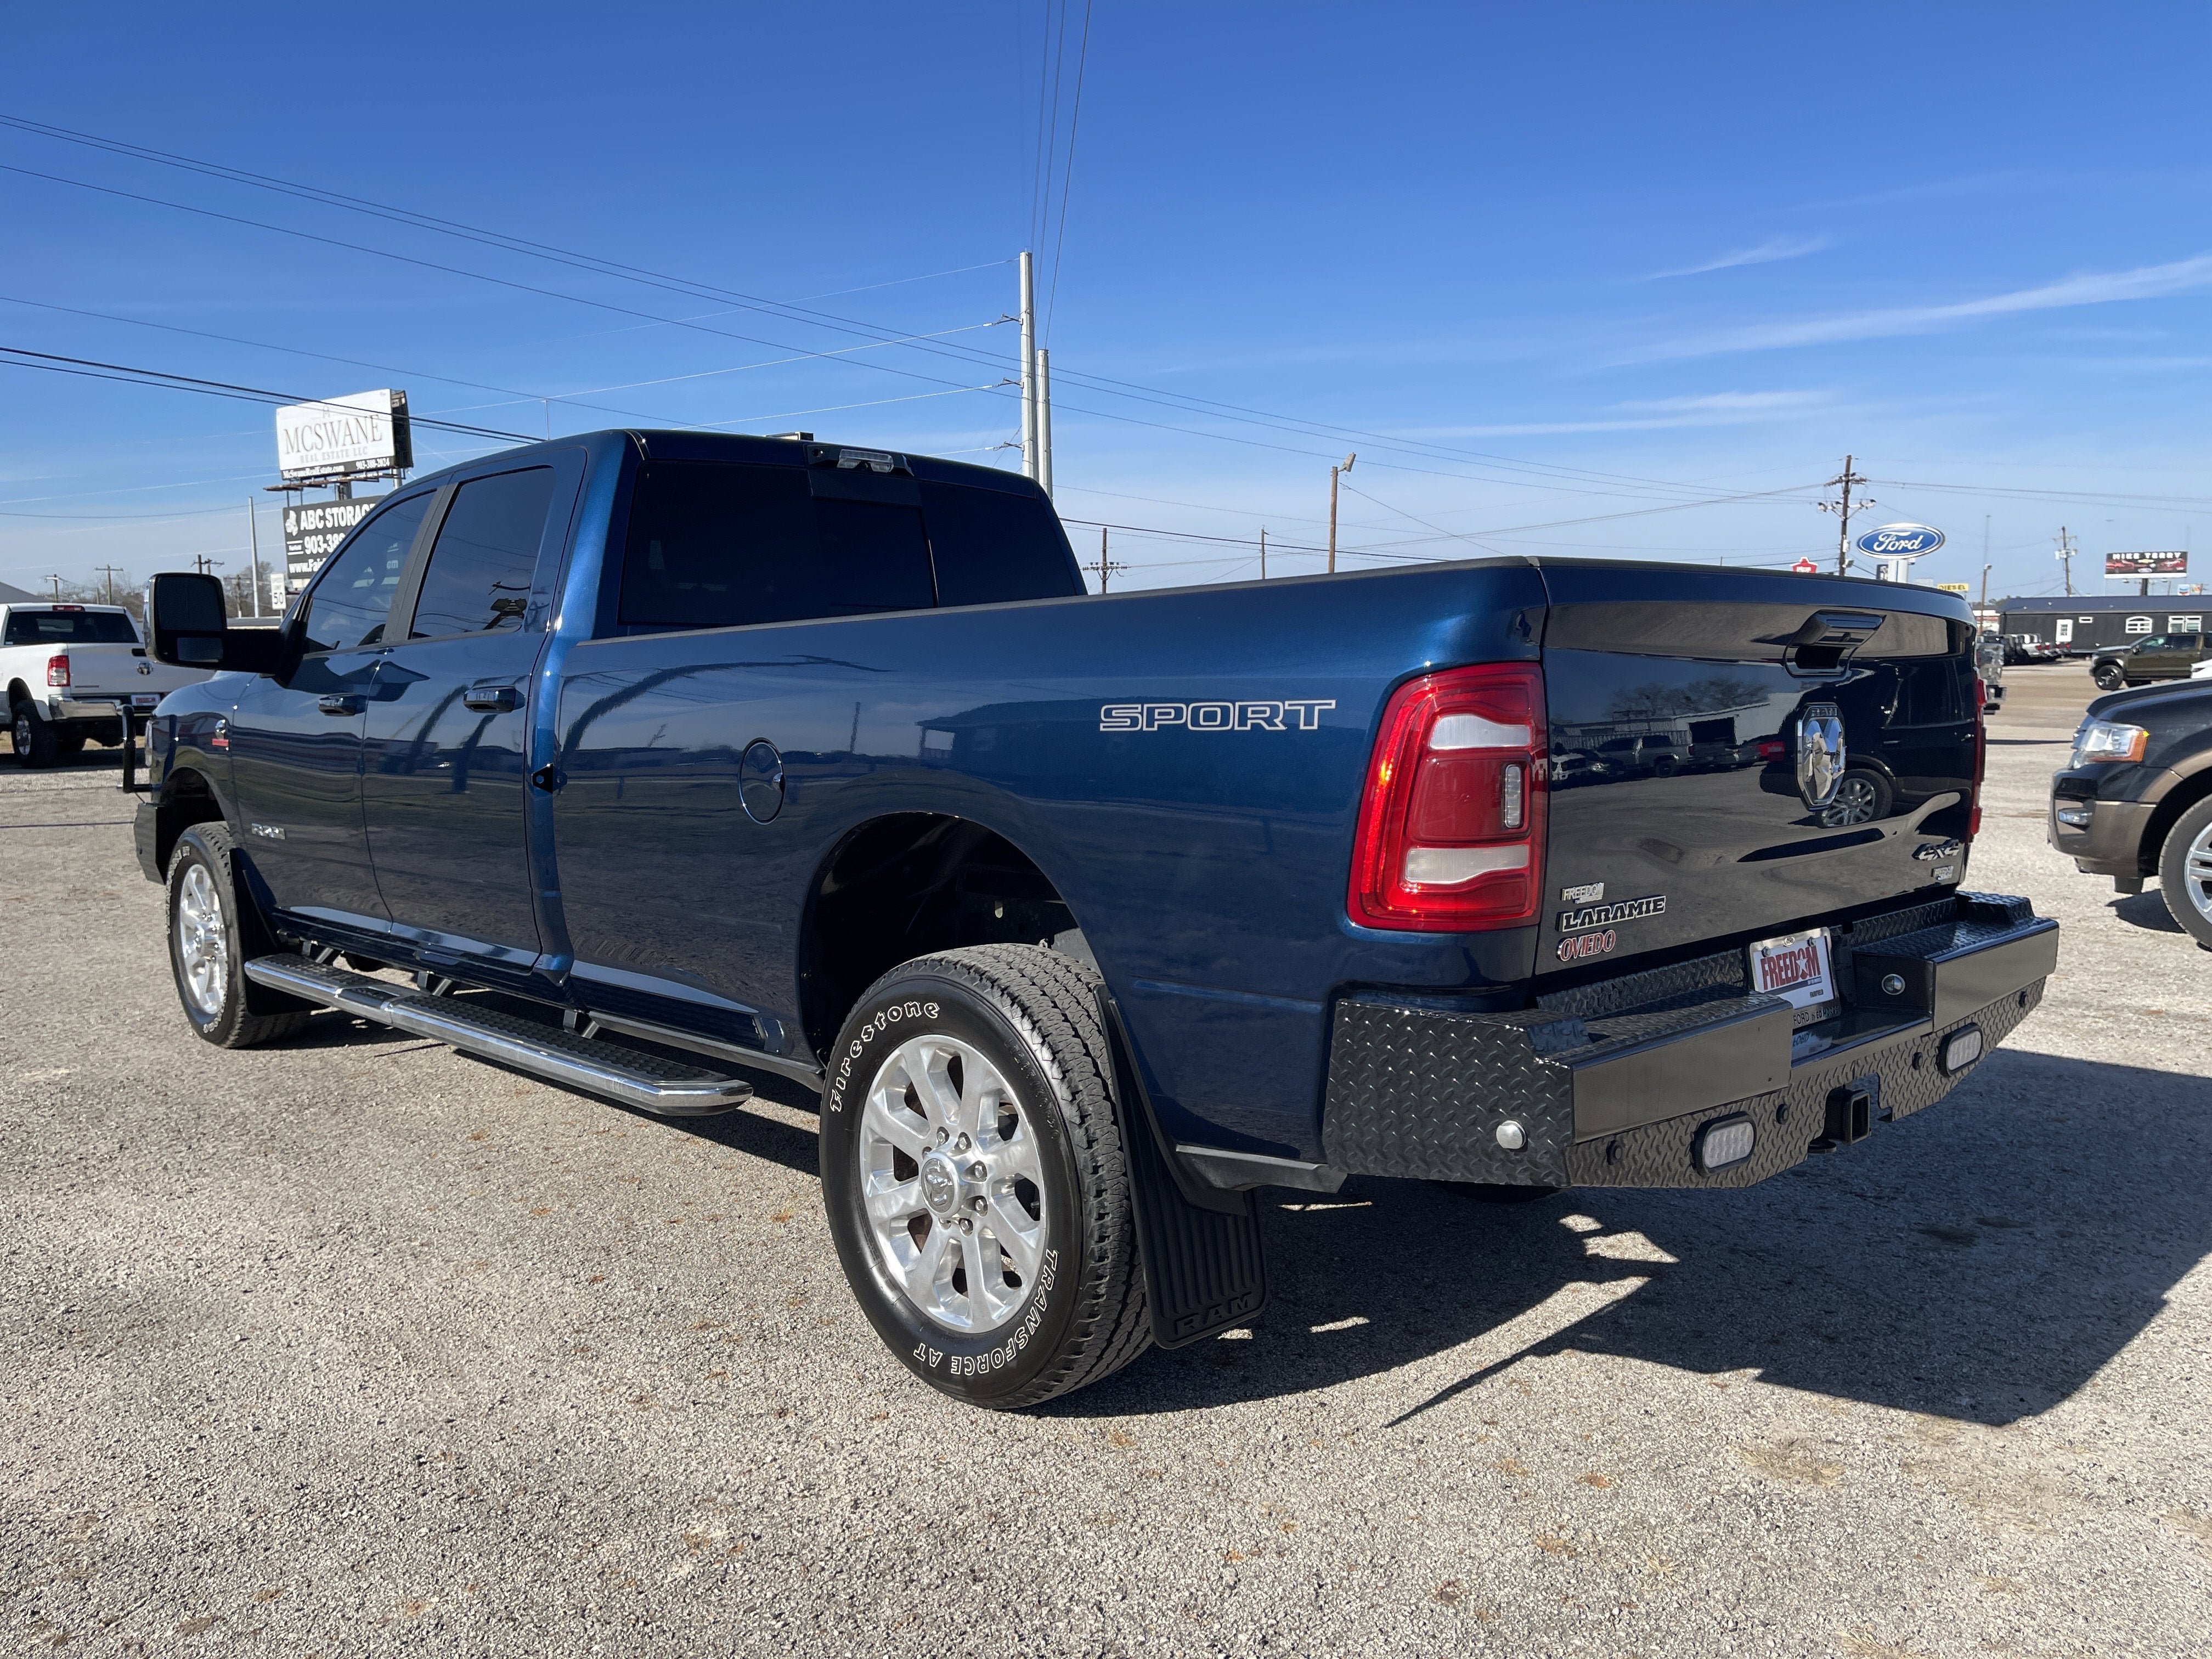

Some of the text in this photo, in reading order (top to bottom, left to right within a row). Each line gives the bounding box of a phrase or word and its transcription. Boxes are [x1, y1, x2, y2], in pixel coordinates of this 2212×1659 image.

[284, 414, 382, 455] MCSWANE
[300, 447, 368, 464] REAL ESTATE LLC
[300, 504, 376, 531] ABC STORA
[1873, 531, 1922, 551] Ford
[289, 558, 326, 573] www.Fair
[274, 592, 283, 604] 50
[1099, 699, 1338, 731] SPORT
[1562, 895, 1667, 932] LARAMIE
[1559, 929, 1616, 962] OVIEDO
[1760, 945, 1821, 990] FREEDOM
[1793, 1012, 1810, 1026] FORD
[830, 1001, 940, 1113] Firestone
[913, 1249, 1059, 1376] TRANSFORCE AT
[1175, 1291, 1252, 1335] RAM
